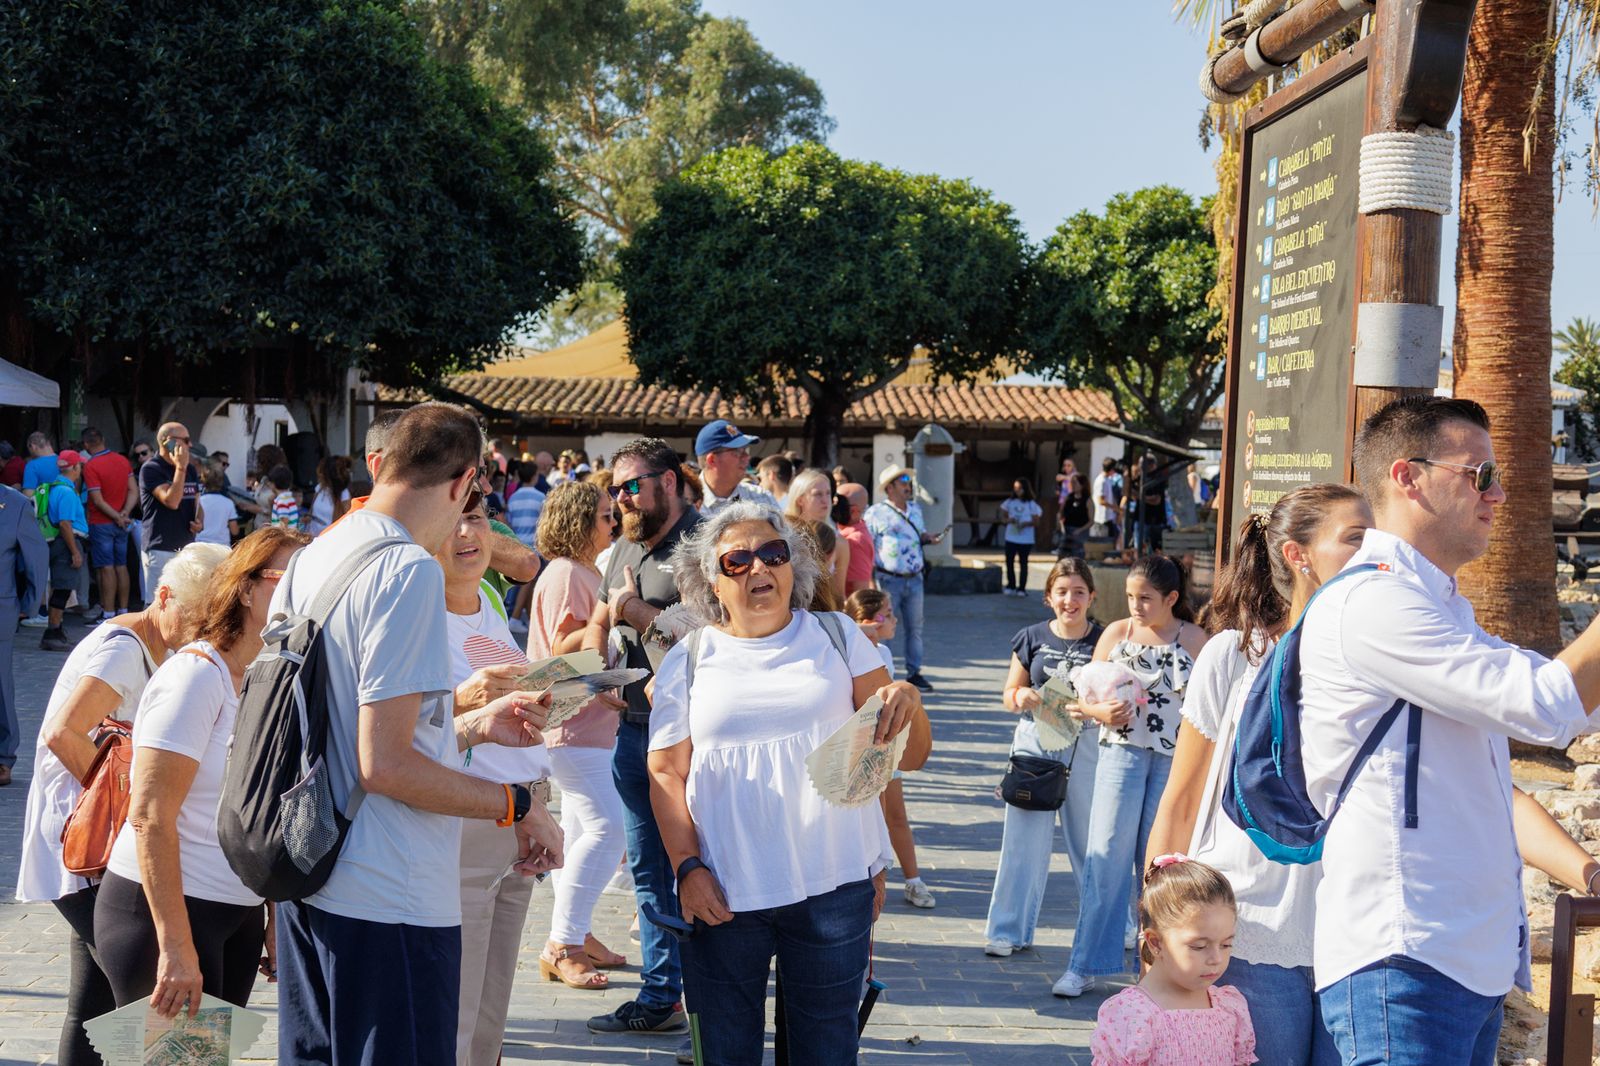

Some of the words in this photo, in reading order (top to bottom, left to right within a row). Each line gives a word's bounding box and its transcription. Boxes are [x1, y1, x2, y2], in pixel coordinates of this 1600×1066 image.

[1279, 148, 1309, 178] CARABELA
[1274, 230, 1304, 256] CARABELA
[1298, 260, 1336, 291] ENCUENTRO
[1269, 313, 1290, 336] BARRIO
[1290, 306, 1322, 334] MEDIEVAL
[1267, 355, 1280, 376] BAR
